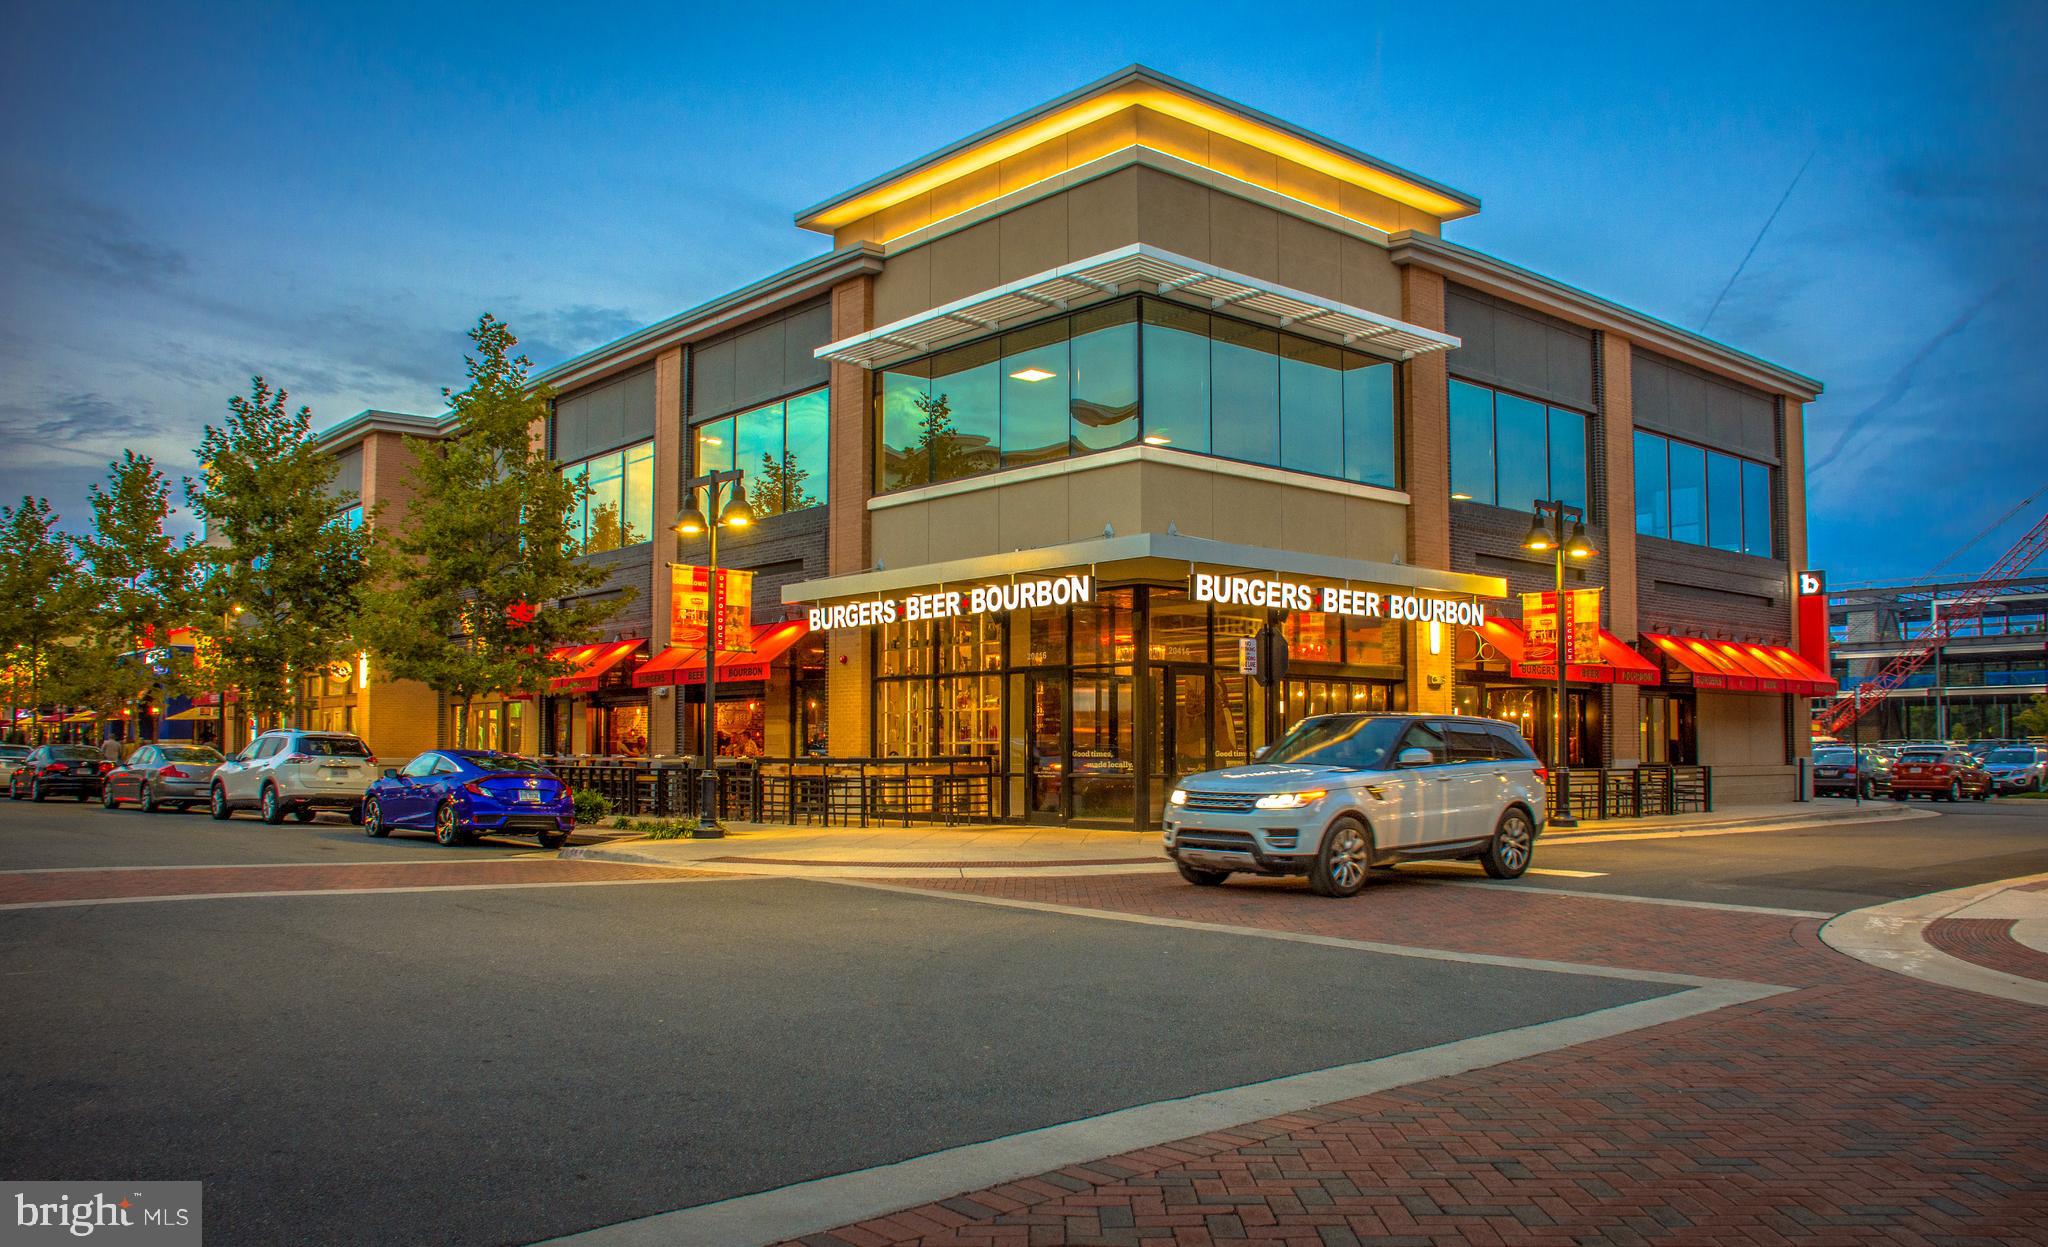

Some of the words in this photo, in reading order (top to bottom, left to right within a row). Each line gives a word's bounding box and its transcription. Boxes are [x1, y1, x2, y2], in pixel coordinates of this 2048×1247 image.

[1801, 574, 1820, 594] b
[809, 599, 896, 632] BURGERS
[906, 591, 961, 621] BEER
[971, 575, 1089, 613] BOURBON
[1196, 573, 1312, 611] BURGERS
[1323, 587, 1380, 617] BEER
[1390, 594, 1484, 627] BOURBON
[687, 671, 704, 680] BEER
[728, 667, 763, 678] BOURBON
[1521, 665, 1556, 675] BURGERS
